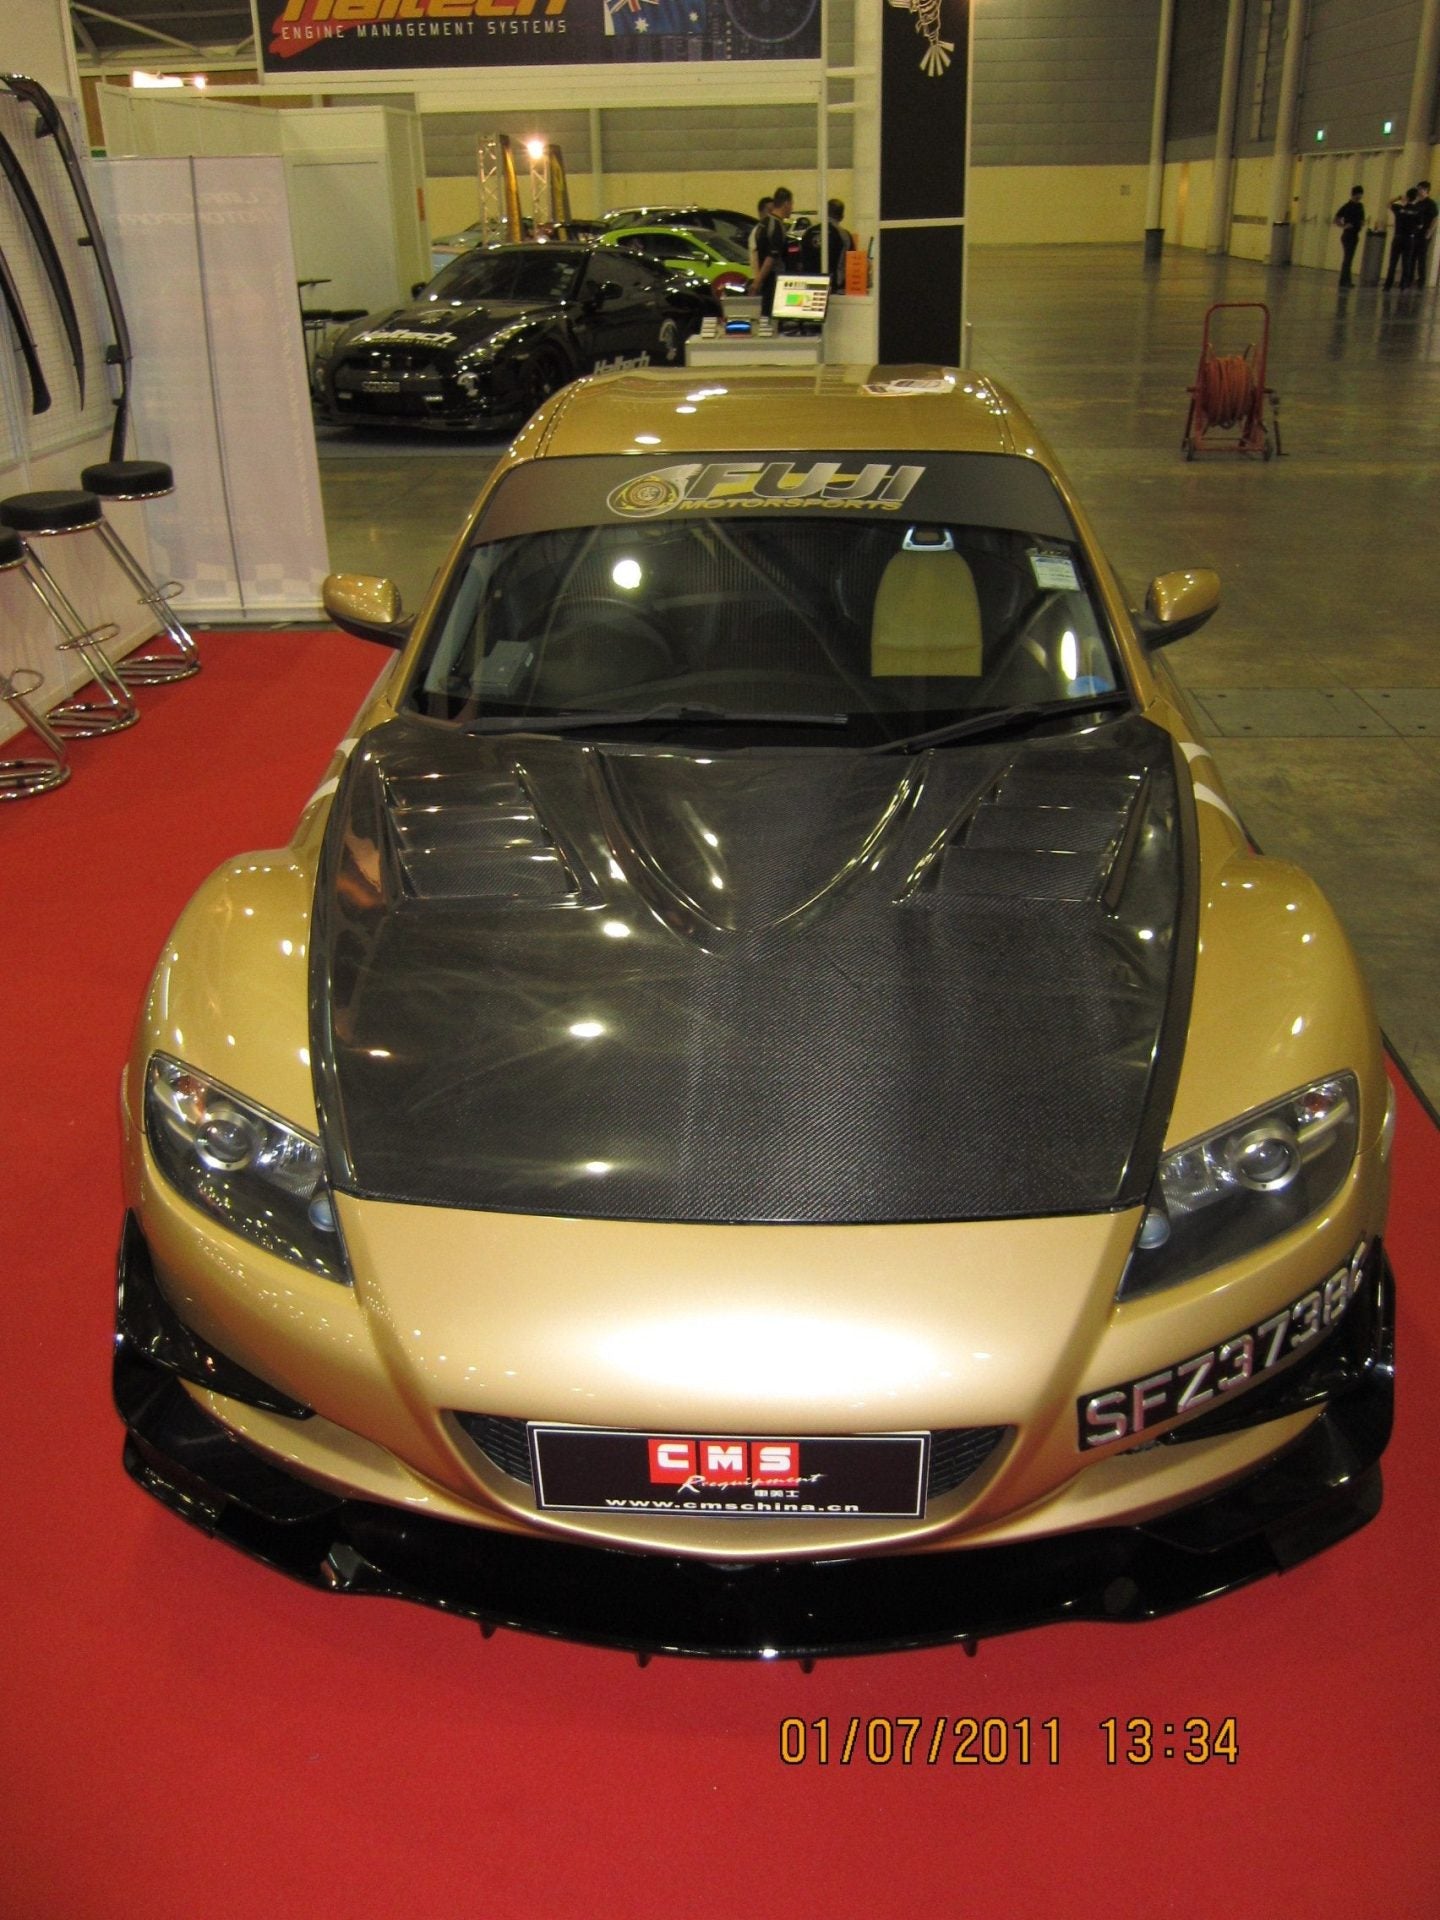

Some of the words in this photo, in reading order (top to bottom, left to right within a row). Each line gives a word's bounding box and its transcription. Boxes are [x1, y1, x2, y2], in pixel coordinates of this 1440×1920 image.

[281, 25, 345, 40] ENGINE
[356, 21, 475, 38] MANAGEMENT
[487, 20, 568, 35] SYSTEMS
[684, 462, 926, 501] FUJI
[679, 499, 903, 511] MOTORSPORTS
[656, 1443, 792, 1472] CMS
[605, 1498, 860, 1512] www.cmschina.cn
